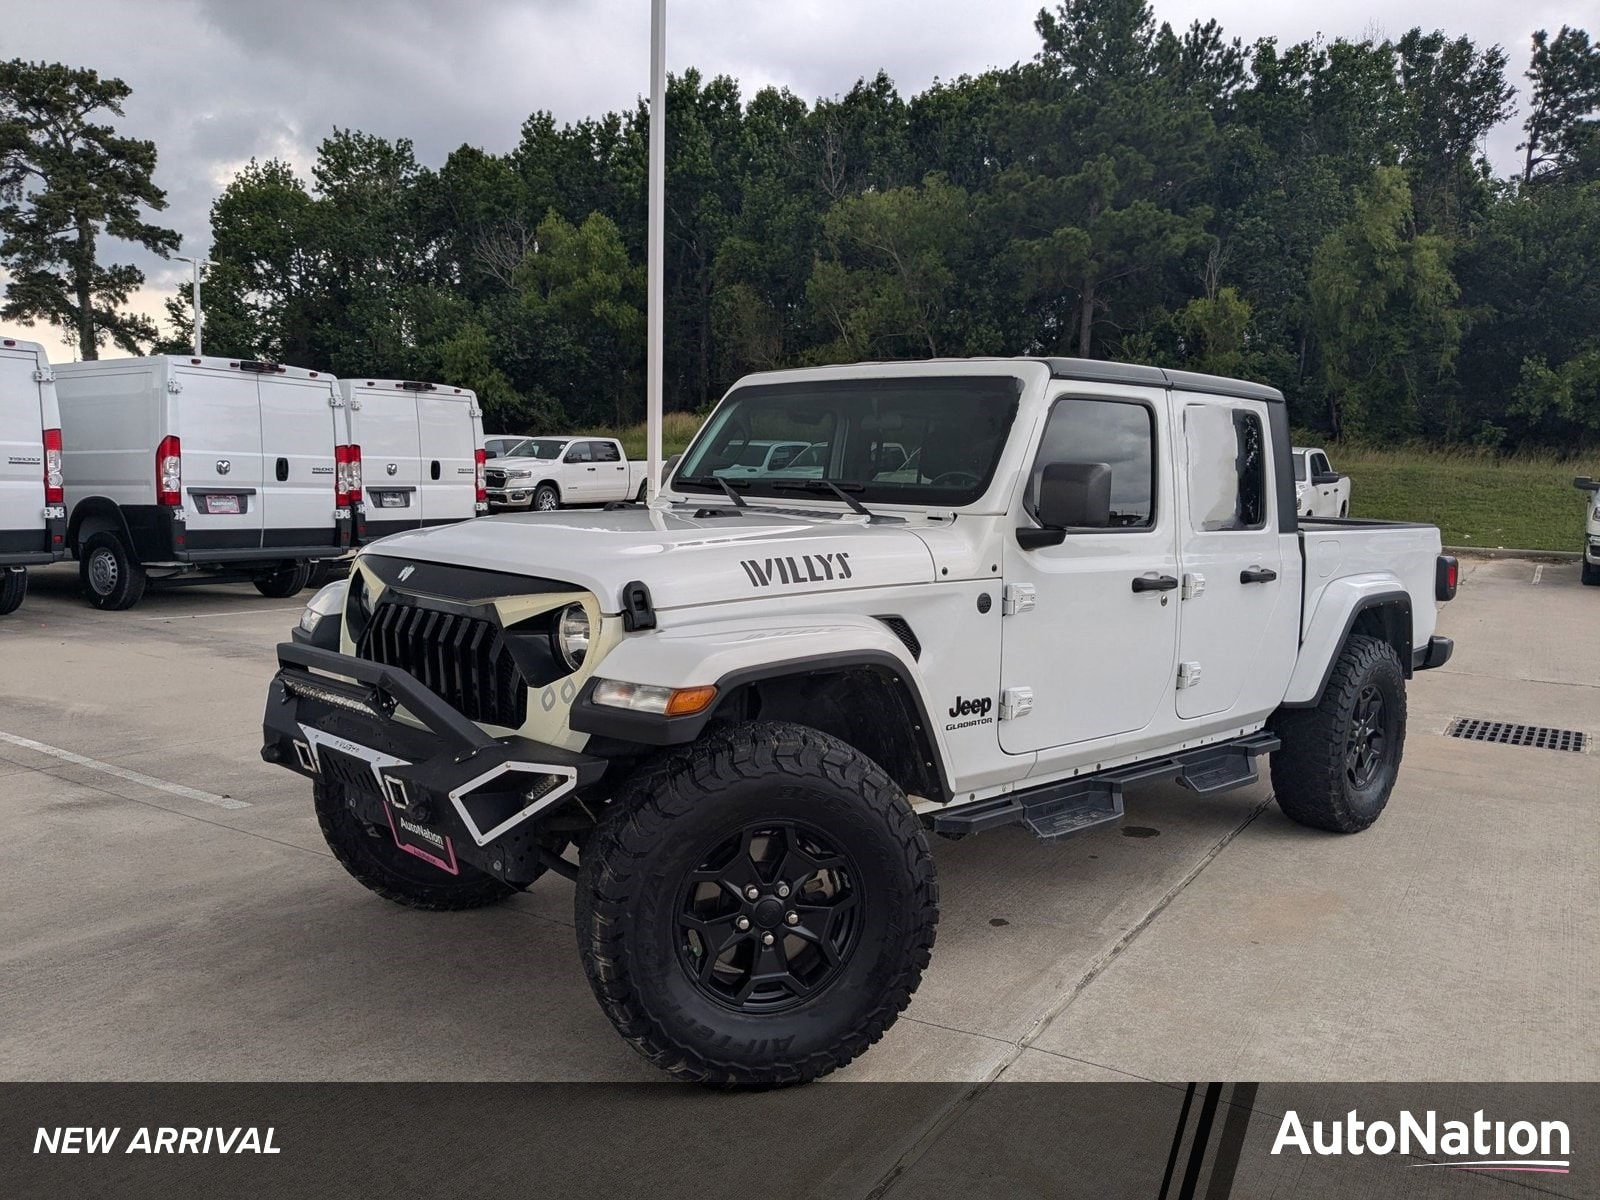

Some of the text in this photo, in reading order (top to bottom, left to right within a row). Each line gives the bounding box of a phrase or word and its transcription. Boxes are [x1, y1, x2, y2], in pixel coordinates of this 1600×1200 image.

[740, 553, 852, 587] WILLYS
[949, 695, 992, 718] Jeep
[945, 717, 993, 731] GLADIATOR
[400, 816, 444, 846] AutoNation
